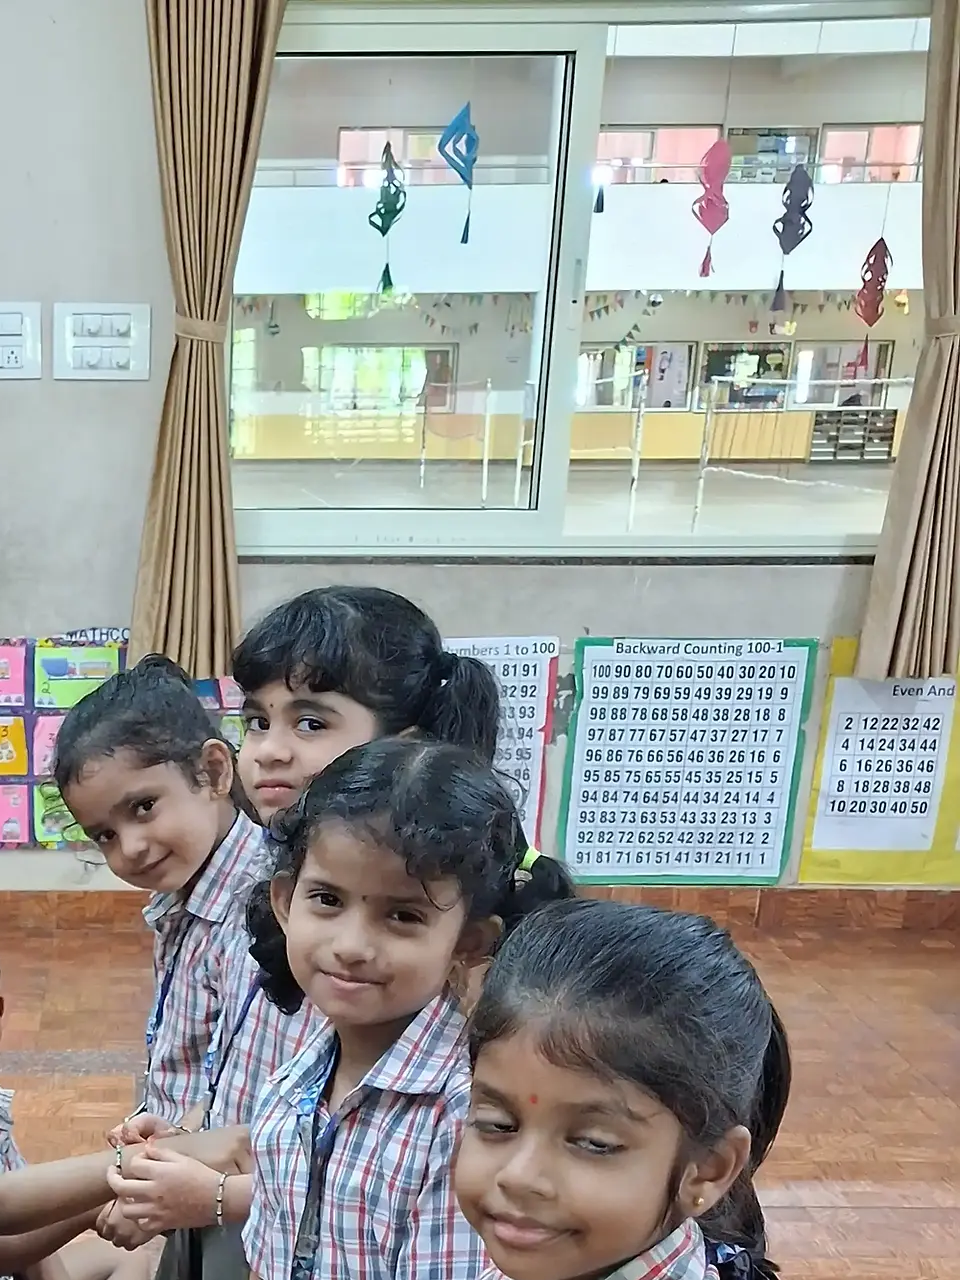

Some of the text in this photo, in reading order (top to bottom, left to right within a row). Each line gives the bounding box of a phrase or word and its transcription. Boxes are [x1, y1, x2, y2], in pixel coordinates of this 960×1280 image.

[504, 643, 511, 655] 1
[515, 645, 529, 655] to
[532, 642, 555, 654] 100
[616, 641, 783, 656] Backward Counting 100-1
[502, 663, 537, 677] 81 91
[593, 664, 796, 679] 100 90 80 70 60 50 40 30 20 10
[520, 684, 537, 698] 92
[592, 686, 789, 701] 99 89 79 69 59 49 39 29 19 9
[892, 684, 956, 697] Even And
[518, 705, 535, 719] 93
[590, 707, 786, 722] 98 88 78 68 58 48 38 28 18 8
[844, 717, 941, 731] 2 12 22 32 42
[517, 726, 533, 740] 94
[588, 728, 784, 743] 97 87 77 67 57 47 37 27 17 7
[841, 737, 937, 752] 4 14 24 34 44
[515, 747, 532, 761] 95
[585, 749, 781, 763] 96 86 76 66 56 46 36 26 16 6
[839, 758, 934, 773] 6 16 26 36 46
[514, 767, 530, 781] 96
[583, 769, 778, 784] 95 85 75 65 55 45 35 25 15 5
[836, 779, 931, 794] 8 18 28 38 48
[830, 799, 928, 814] 10 20 30 40 50
[579, 810, 772, 825] 93 83 73 63 53 43 33 23 13 3
[578, 830, 770, 845] 92 82 72 62 52 42 32 22 12 2
[576, 851, 765, 865] 91 81 71 61 51 41 31 21 11 1
